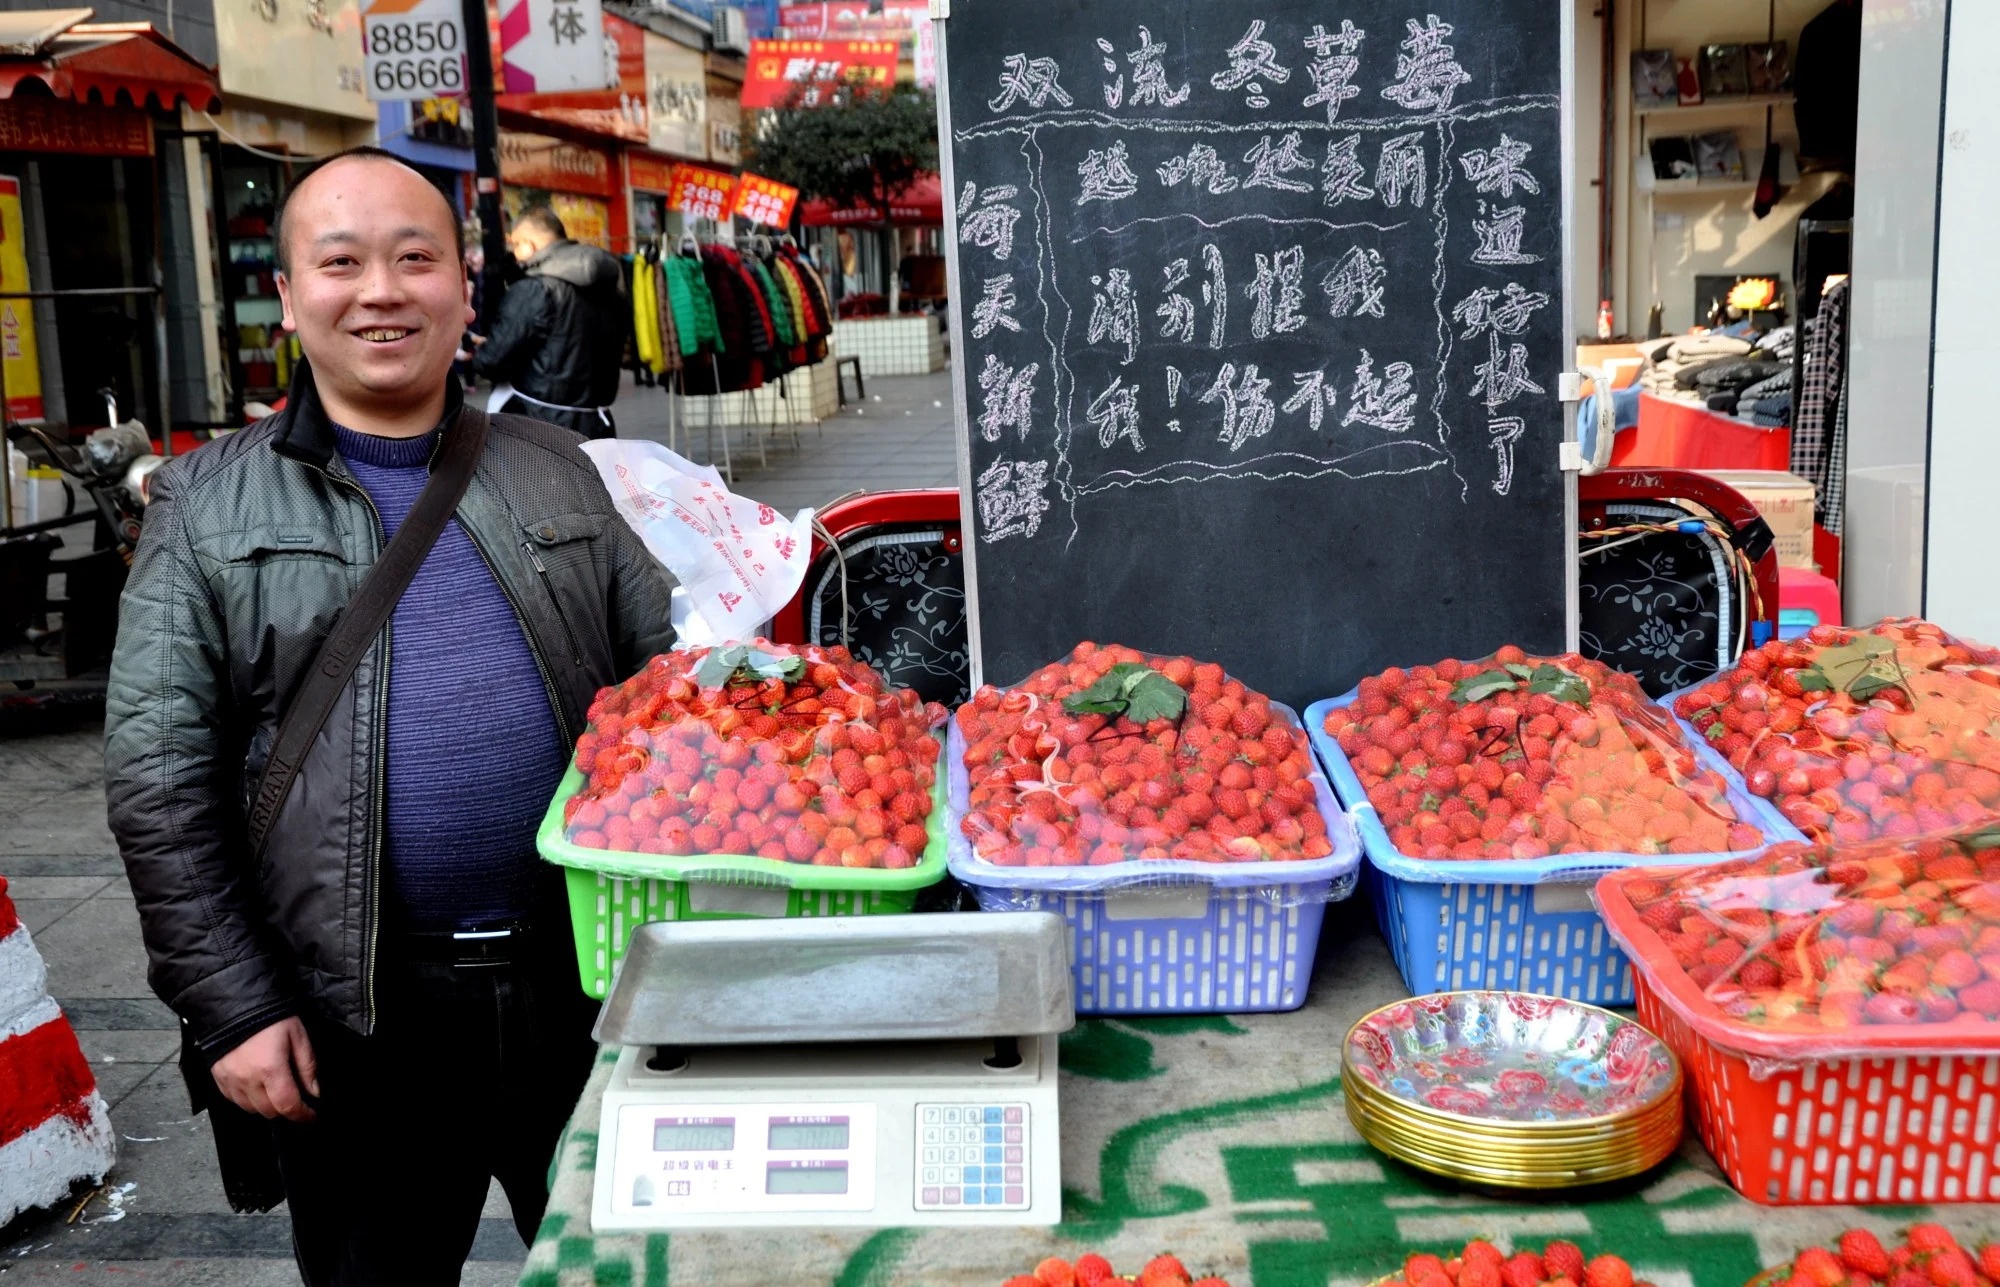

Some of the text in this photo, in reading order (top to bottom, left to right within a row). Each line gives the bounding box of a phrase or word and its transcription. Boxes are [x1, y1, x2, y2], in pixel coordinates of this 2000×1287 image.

[371, 20, 458, 55] 8850
[374, 57, 460, 92] 6666
[988, 14, 1472, 123] 双流冬草莓
[1453, 132, 1549, 496] 味道好极了
[957, 180, 1051, 547] 每天新鲜
[250, 755, 292, 840] ARMANI
[928, 1111, 935, 1120] 7
[948, 1111, 956, 1120] 8
[968, 1111, 976, 1120] 9
[927, 1131, 935, 1140] 4
[948, 1131, 956, 1140] 5
[968, 1130, 976, 1140] 6
[948, 1150, 956, 1160] 2
[969, 1150, 976, 1160] 3
[927, 1171, 935, 1180] 0
